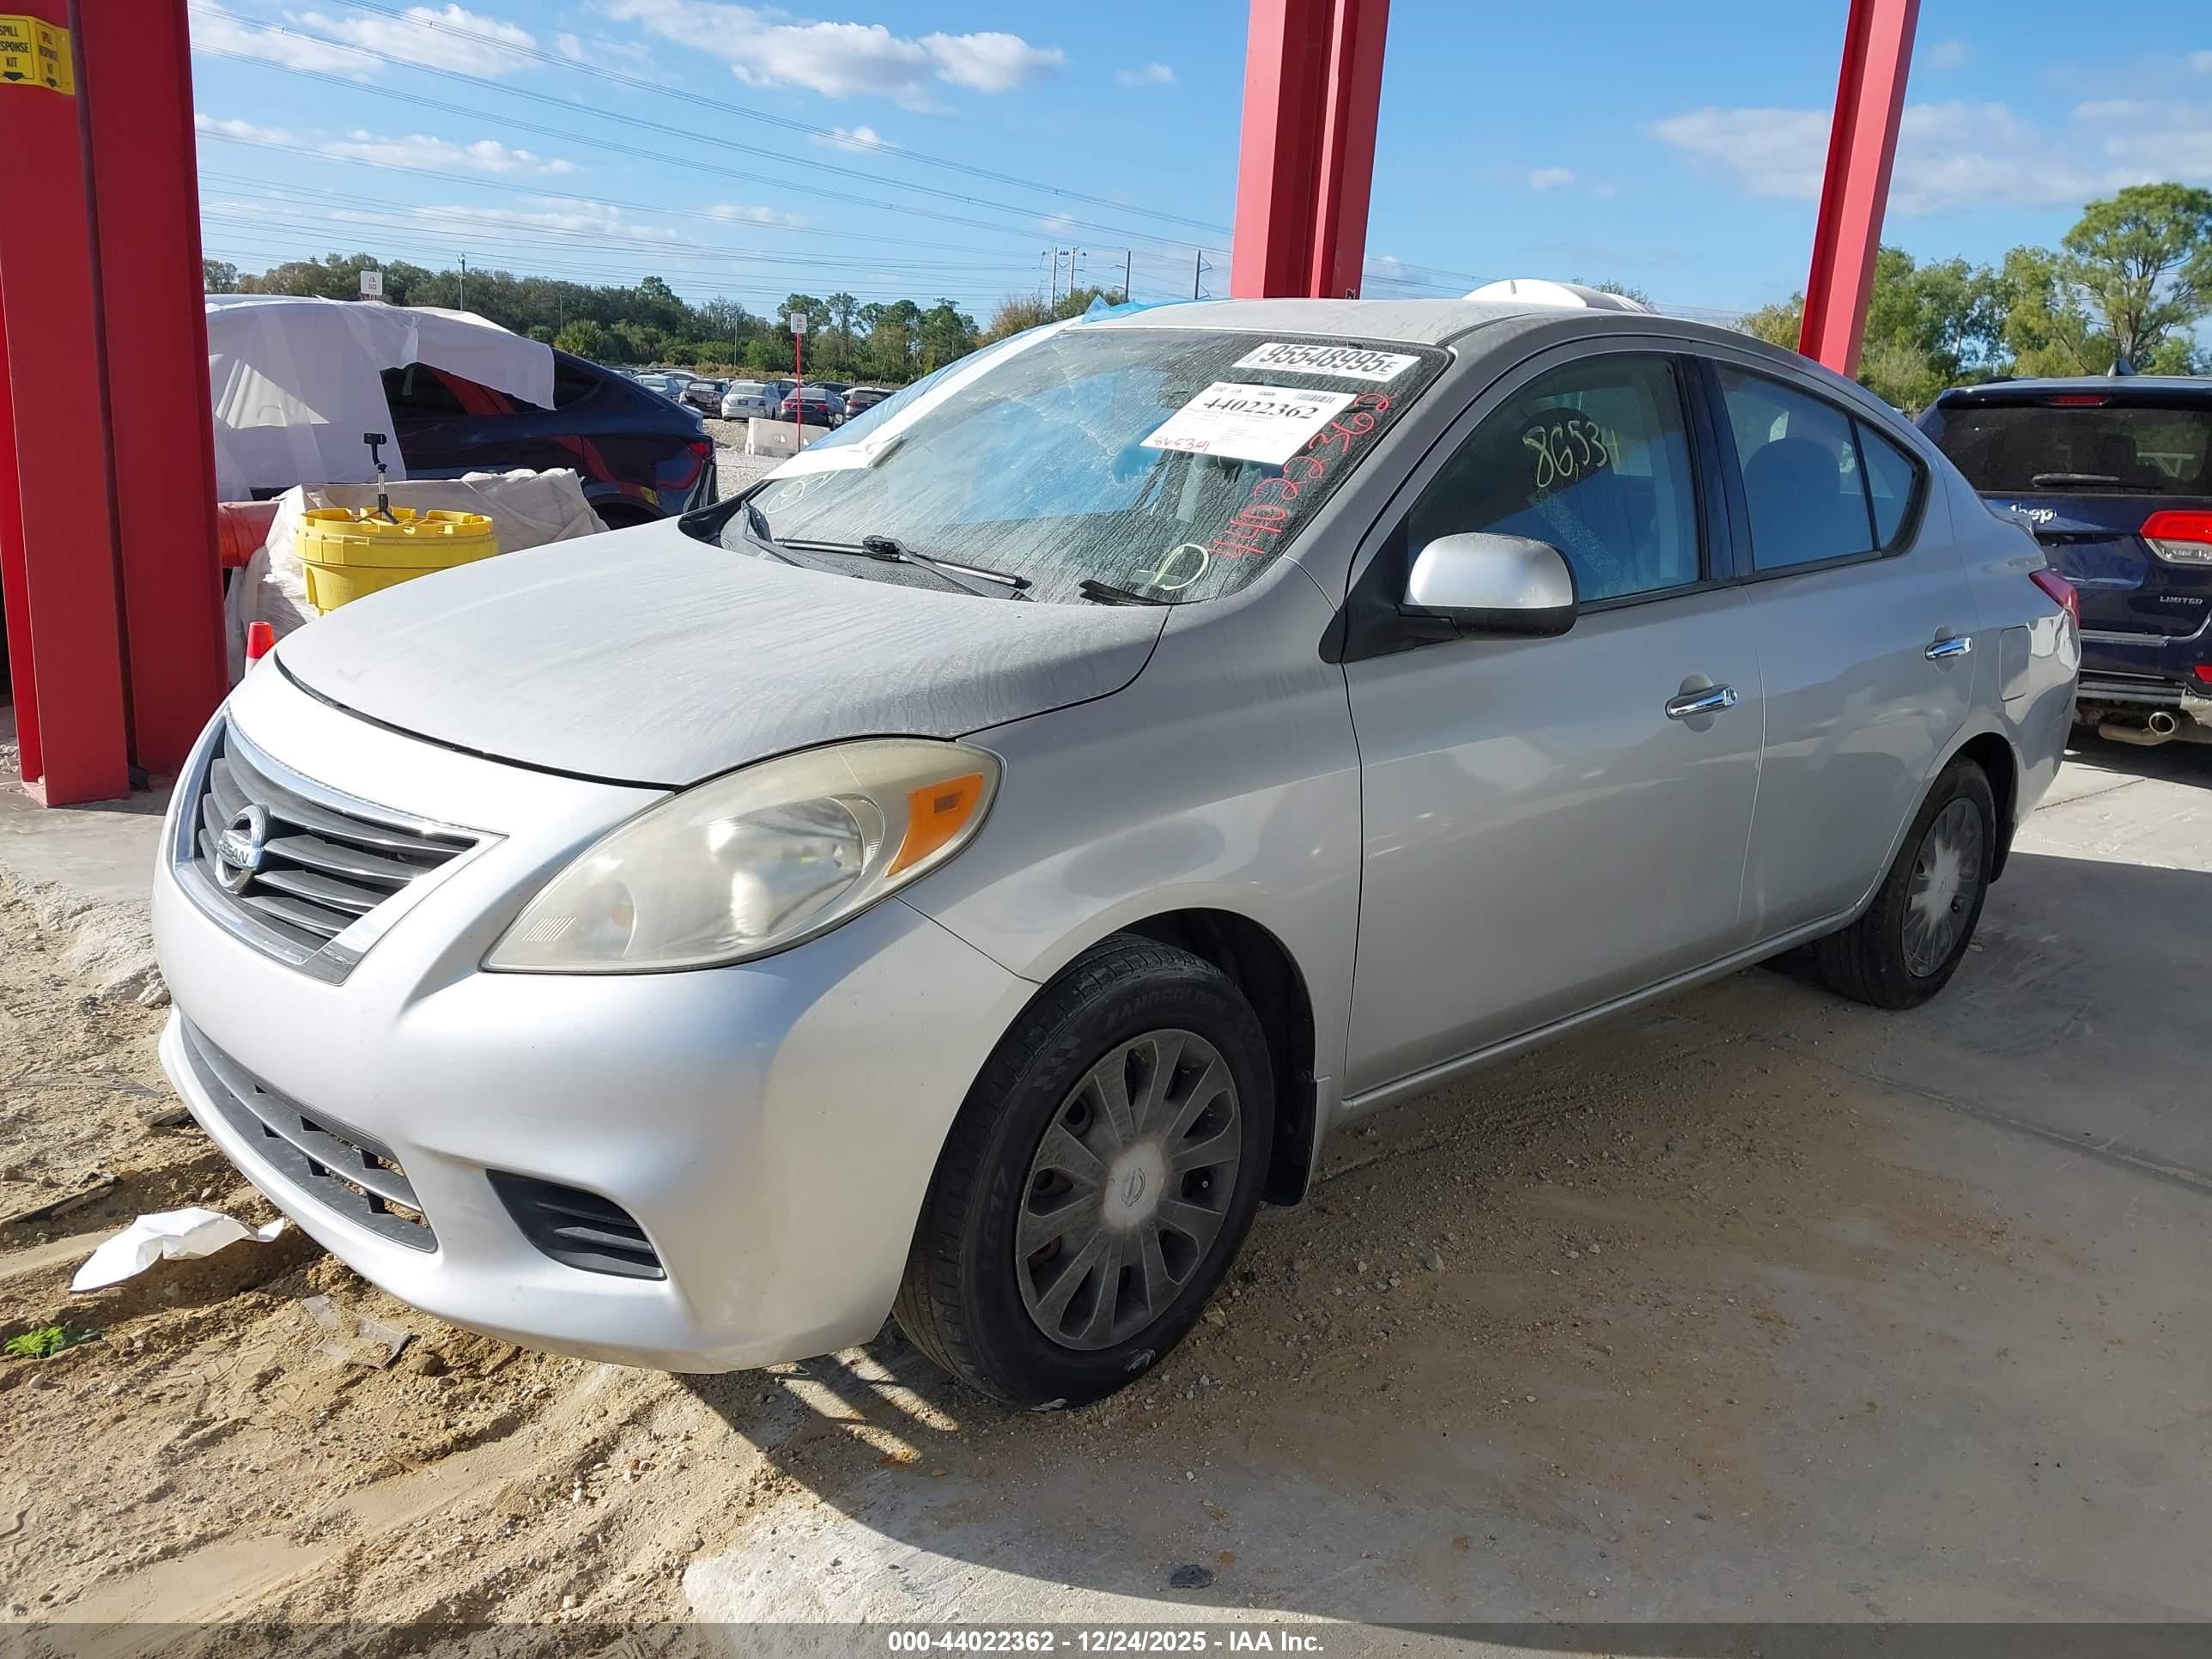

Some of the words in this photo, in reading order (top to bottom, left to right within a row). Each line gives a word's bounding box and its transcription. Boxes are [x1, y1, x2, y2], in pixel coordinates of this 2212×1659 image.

[0, 40, 29, 53] SPONSE
[6, 56, 17, 68] KIT
[1203, 398, 1319, 422] 44022362
[1208, 391, 1399, 560] 44022362
[2160, 596, 2203, 605] LIMITED
